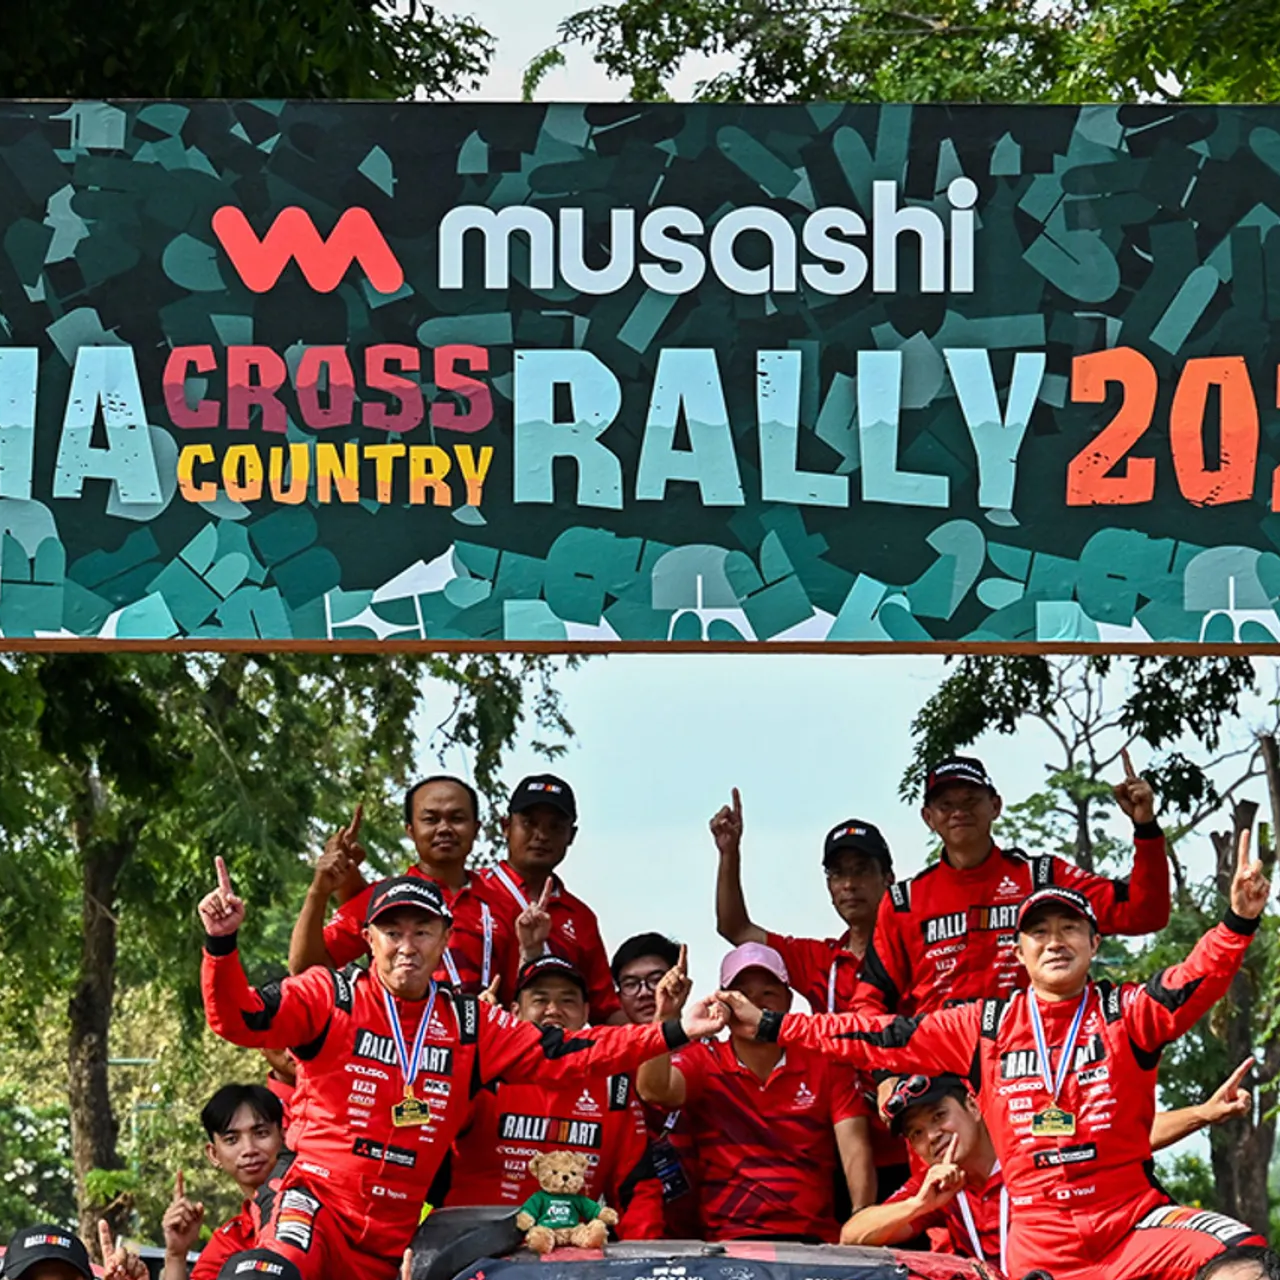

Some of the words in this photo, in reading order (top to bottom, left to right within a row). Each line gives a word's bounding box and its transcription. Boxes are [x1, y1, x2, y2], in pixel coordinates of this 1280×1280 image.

[438, 177, 978, 295] musashi
[163, 344, 494, 434] CROSS
[513, 347, 1047, 511] RALLY
[178, 442, 494, 507] COUNTRY
[503, 1115, 598, 1146] RALLIART
